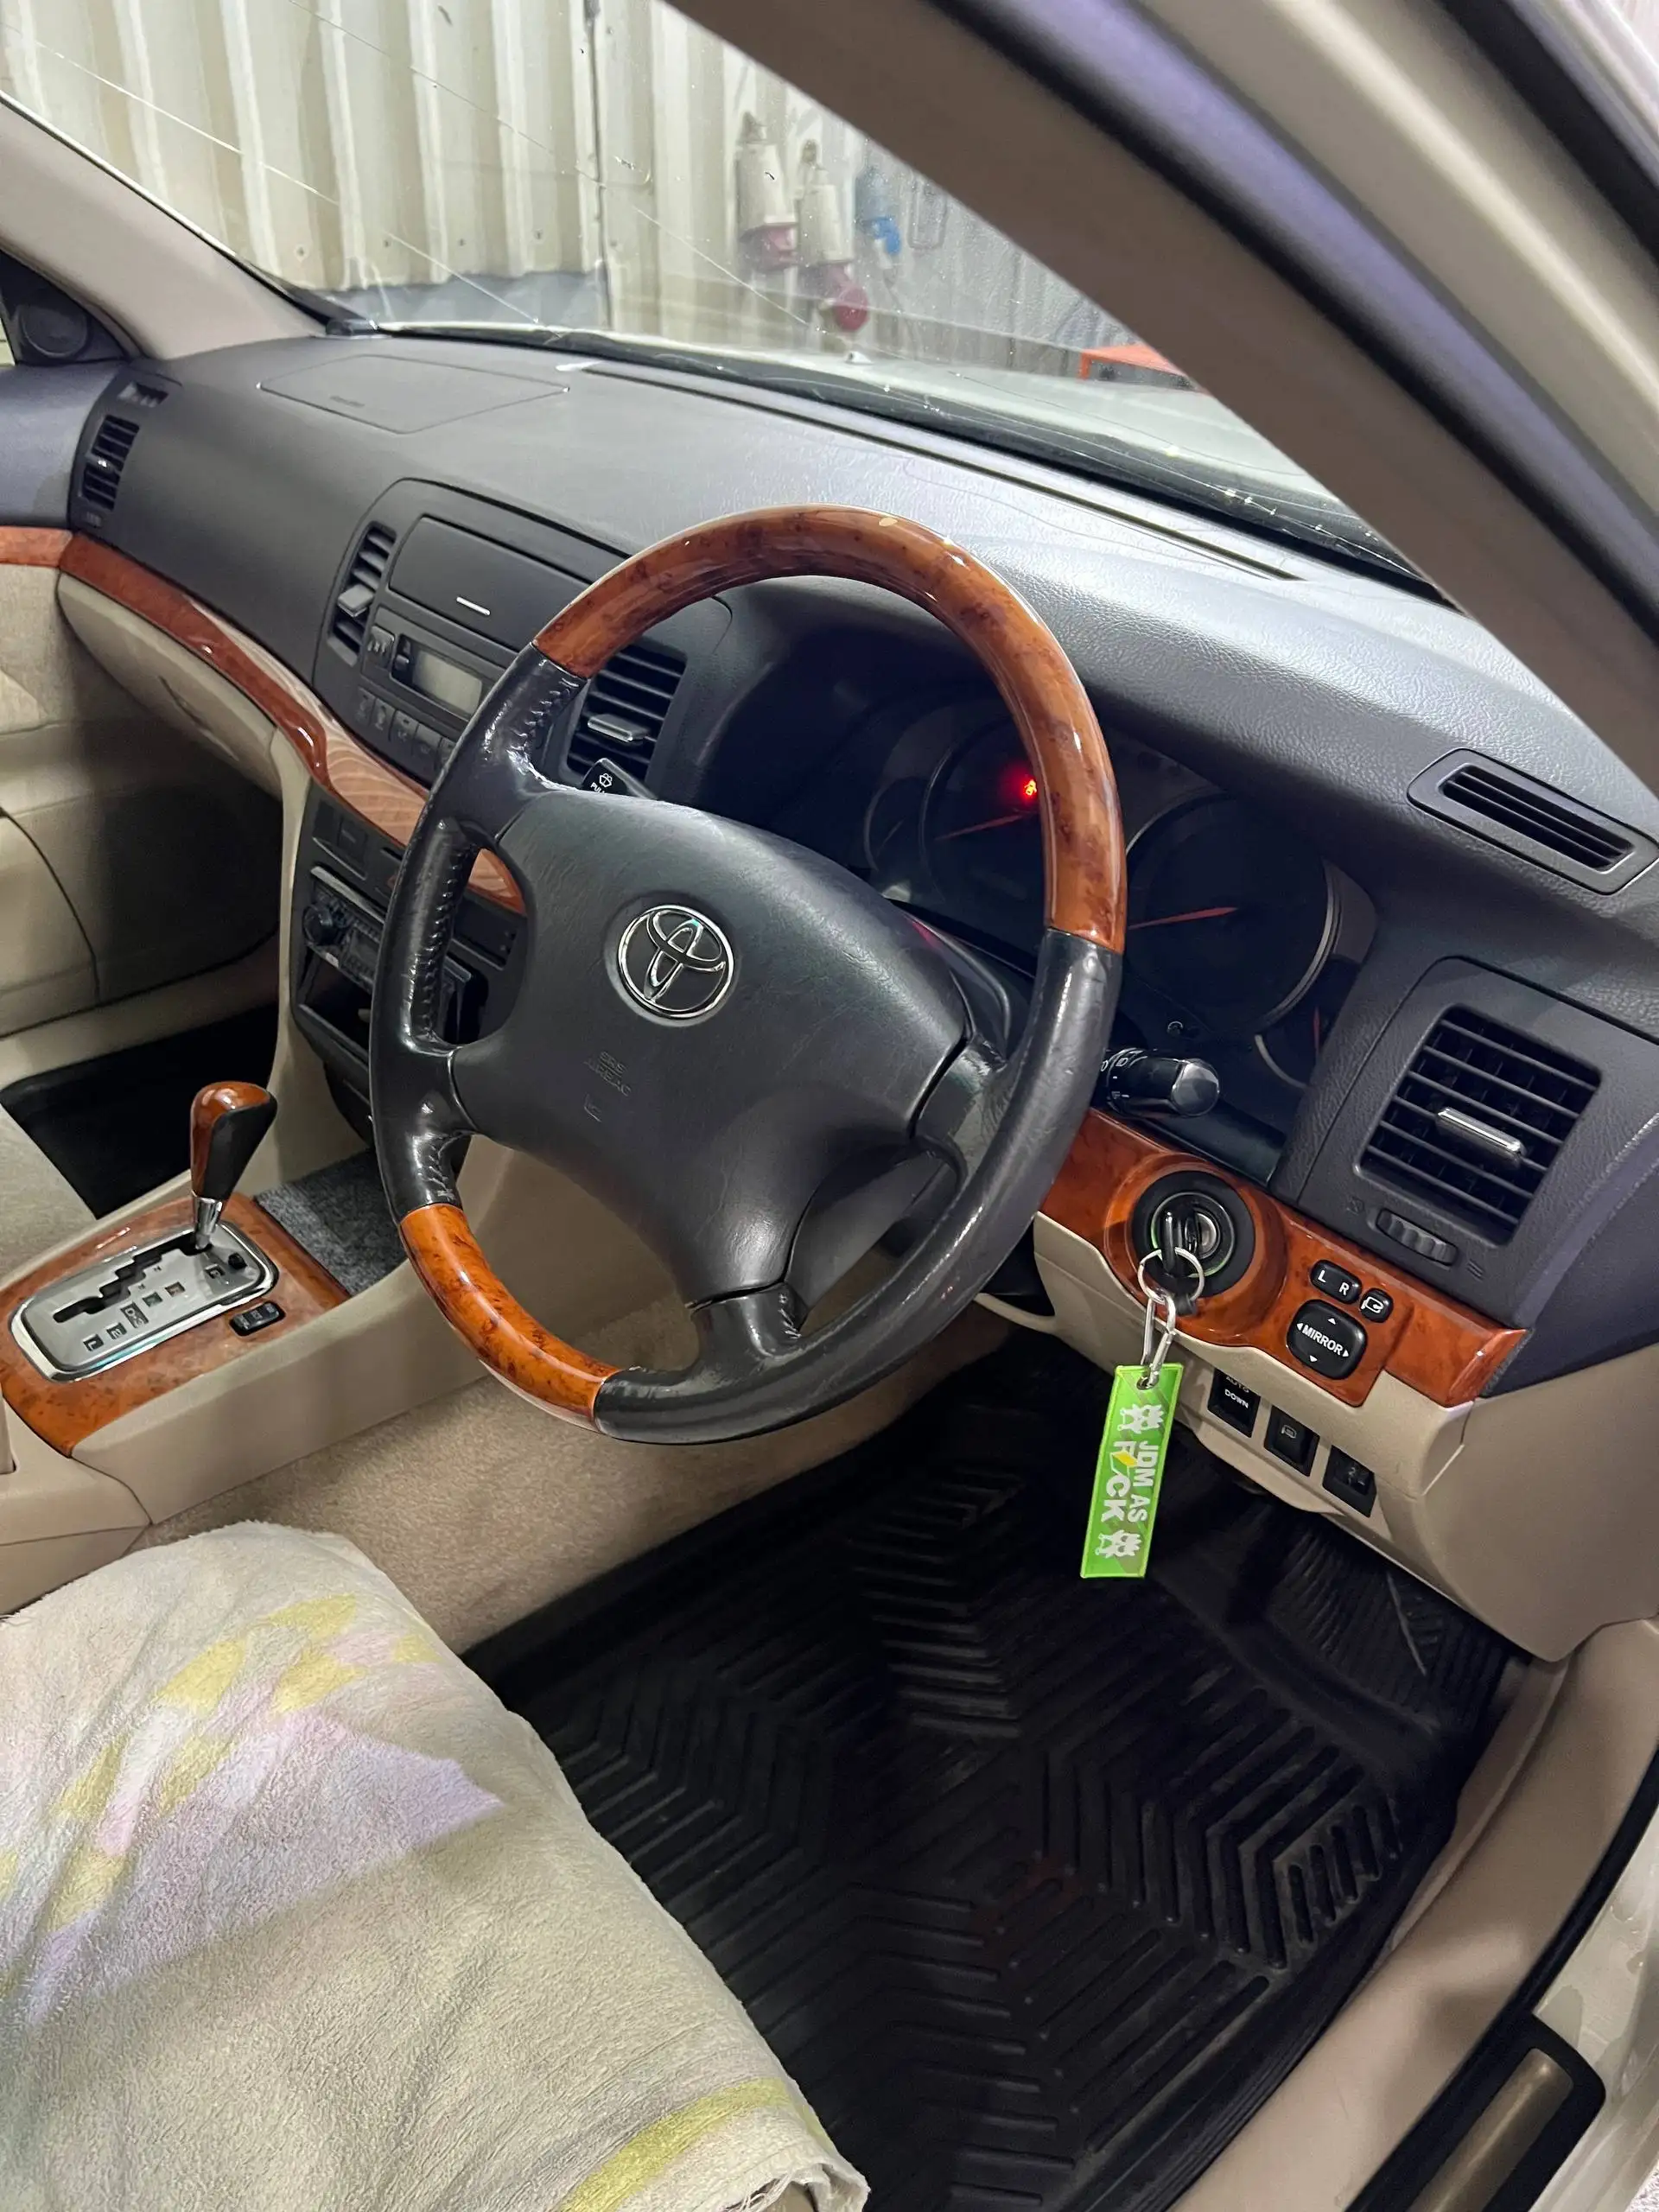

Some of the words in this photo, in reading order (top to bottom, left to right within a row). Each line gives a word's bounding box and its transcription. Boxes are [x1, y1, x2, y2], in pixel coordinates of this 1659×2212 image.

[590, 782, 606, 793] PUL
[1318, 1269, 1326, 1283] L
[1339, 1281, 1350, 1296] R
[1302, 1324, 1344, 1356] MIRROR
[1224, 1389, 1249, 1409] DOWN
[1132, 1440, 1160, 1487] JDM
[1128, 1494, 1151, 1523] AS
